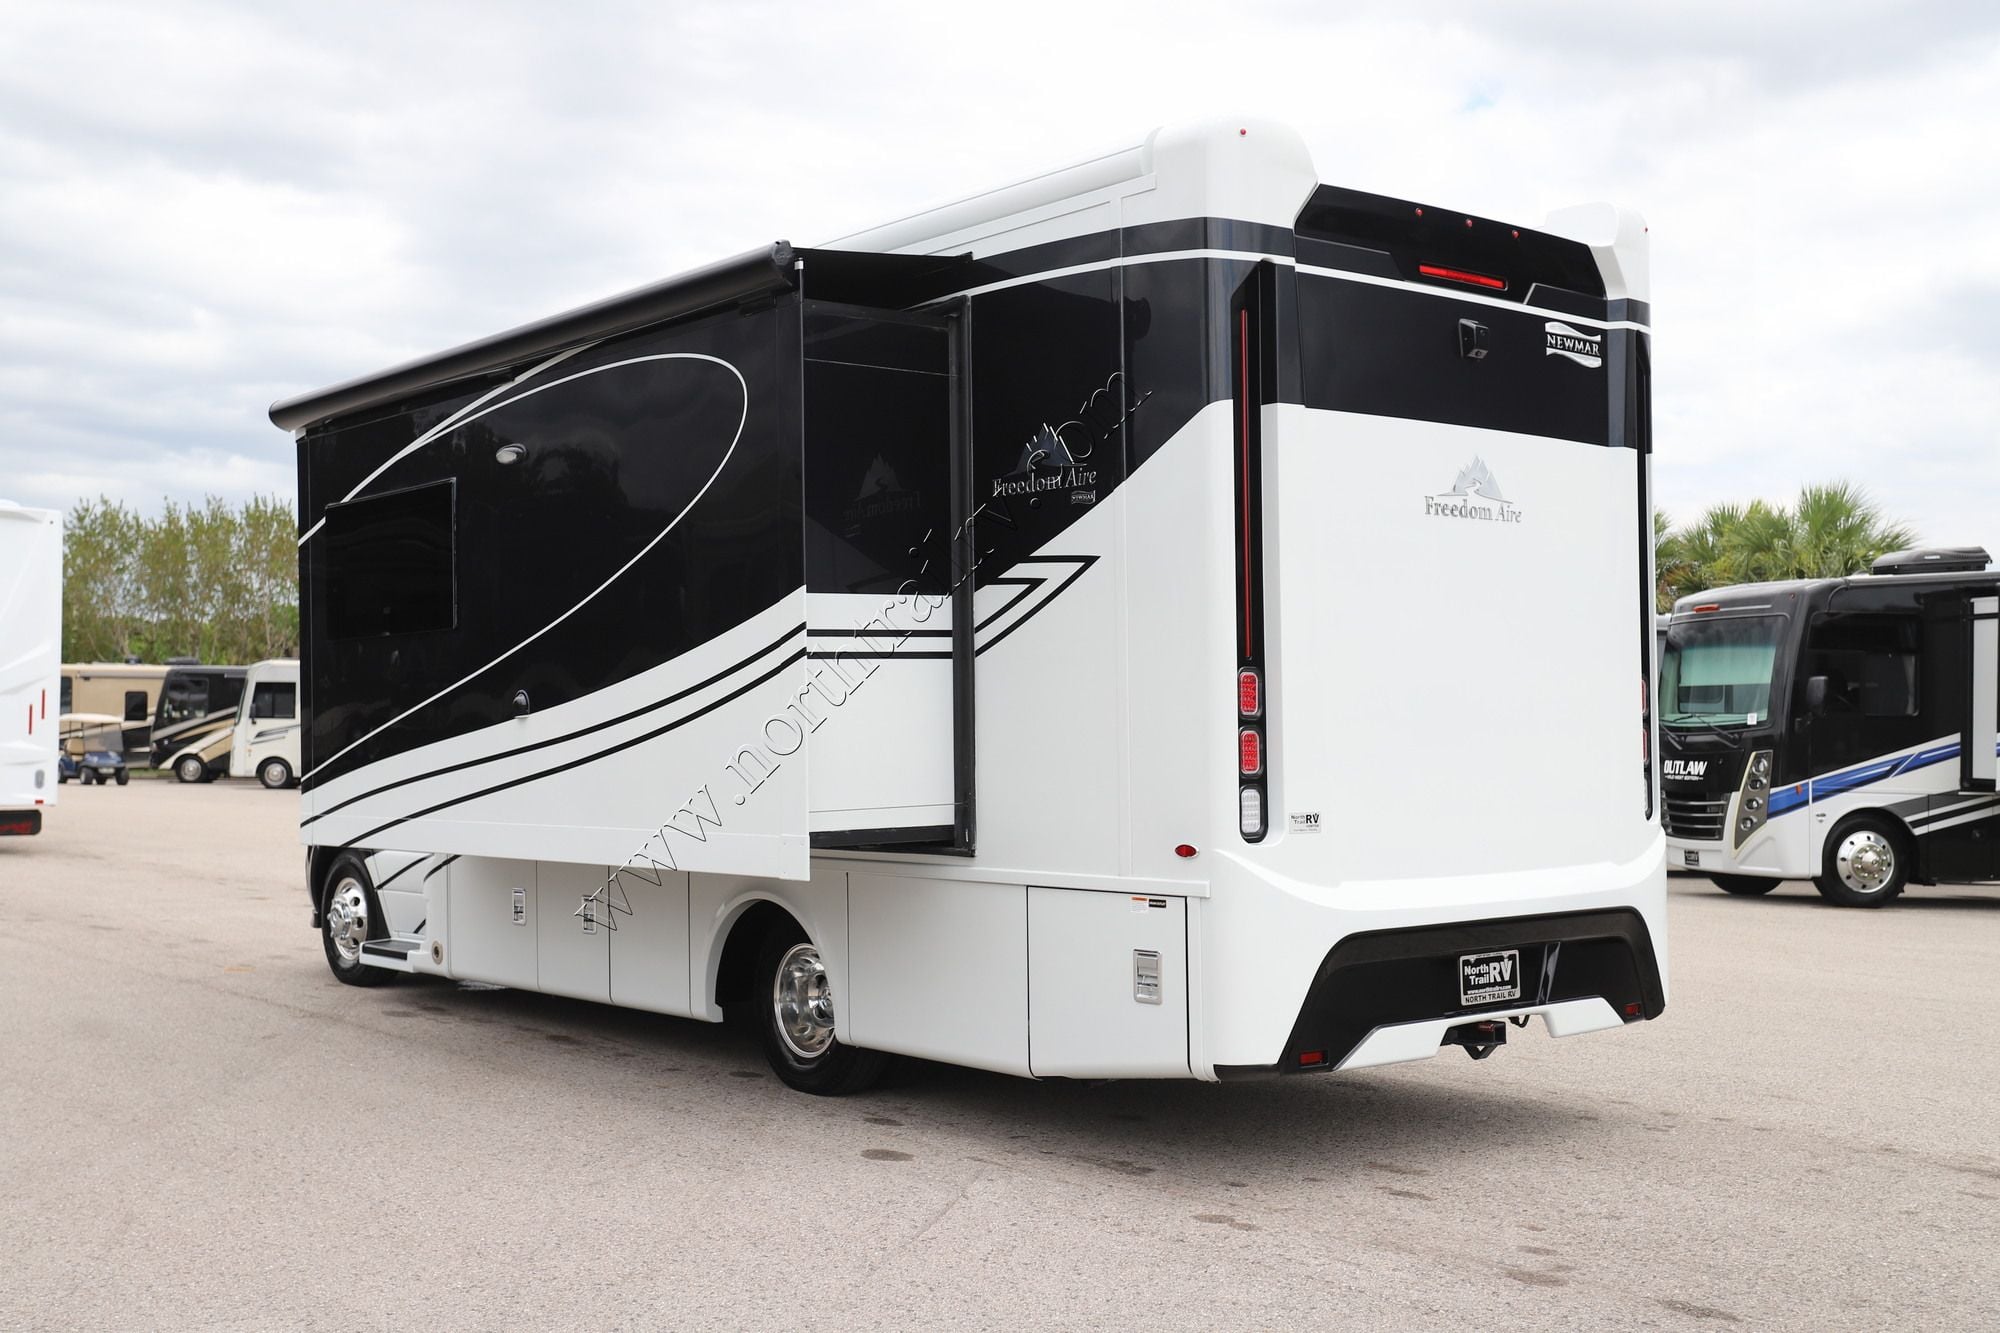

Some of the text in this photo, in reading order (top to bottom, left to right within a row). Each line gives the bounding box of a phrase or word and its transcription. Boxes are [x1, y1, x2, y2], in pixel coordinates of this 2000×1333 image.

[1546, 334, 1600, 355] NEWMAR
[992, 467, 1097, 497] Freedom Aire
[1424, 495, 1522, 523] Freedom Aire
[1664, 760, 1708, 775] OUTLAW
[1306, 813, 1319, 824] RV
[1464, 964, 1489, 975] North
[1489, 959, 1513, 982] RV
[1469, 974, 1489, 985] Trail
[1465, 990, 1516, 1003] NORTH TRAIL RV
